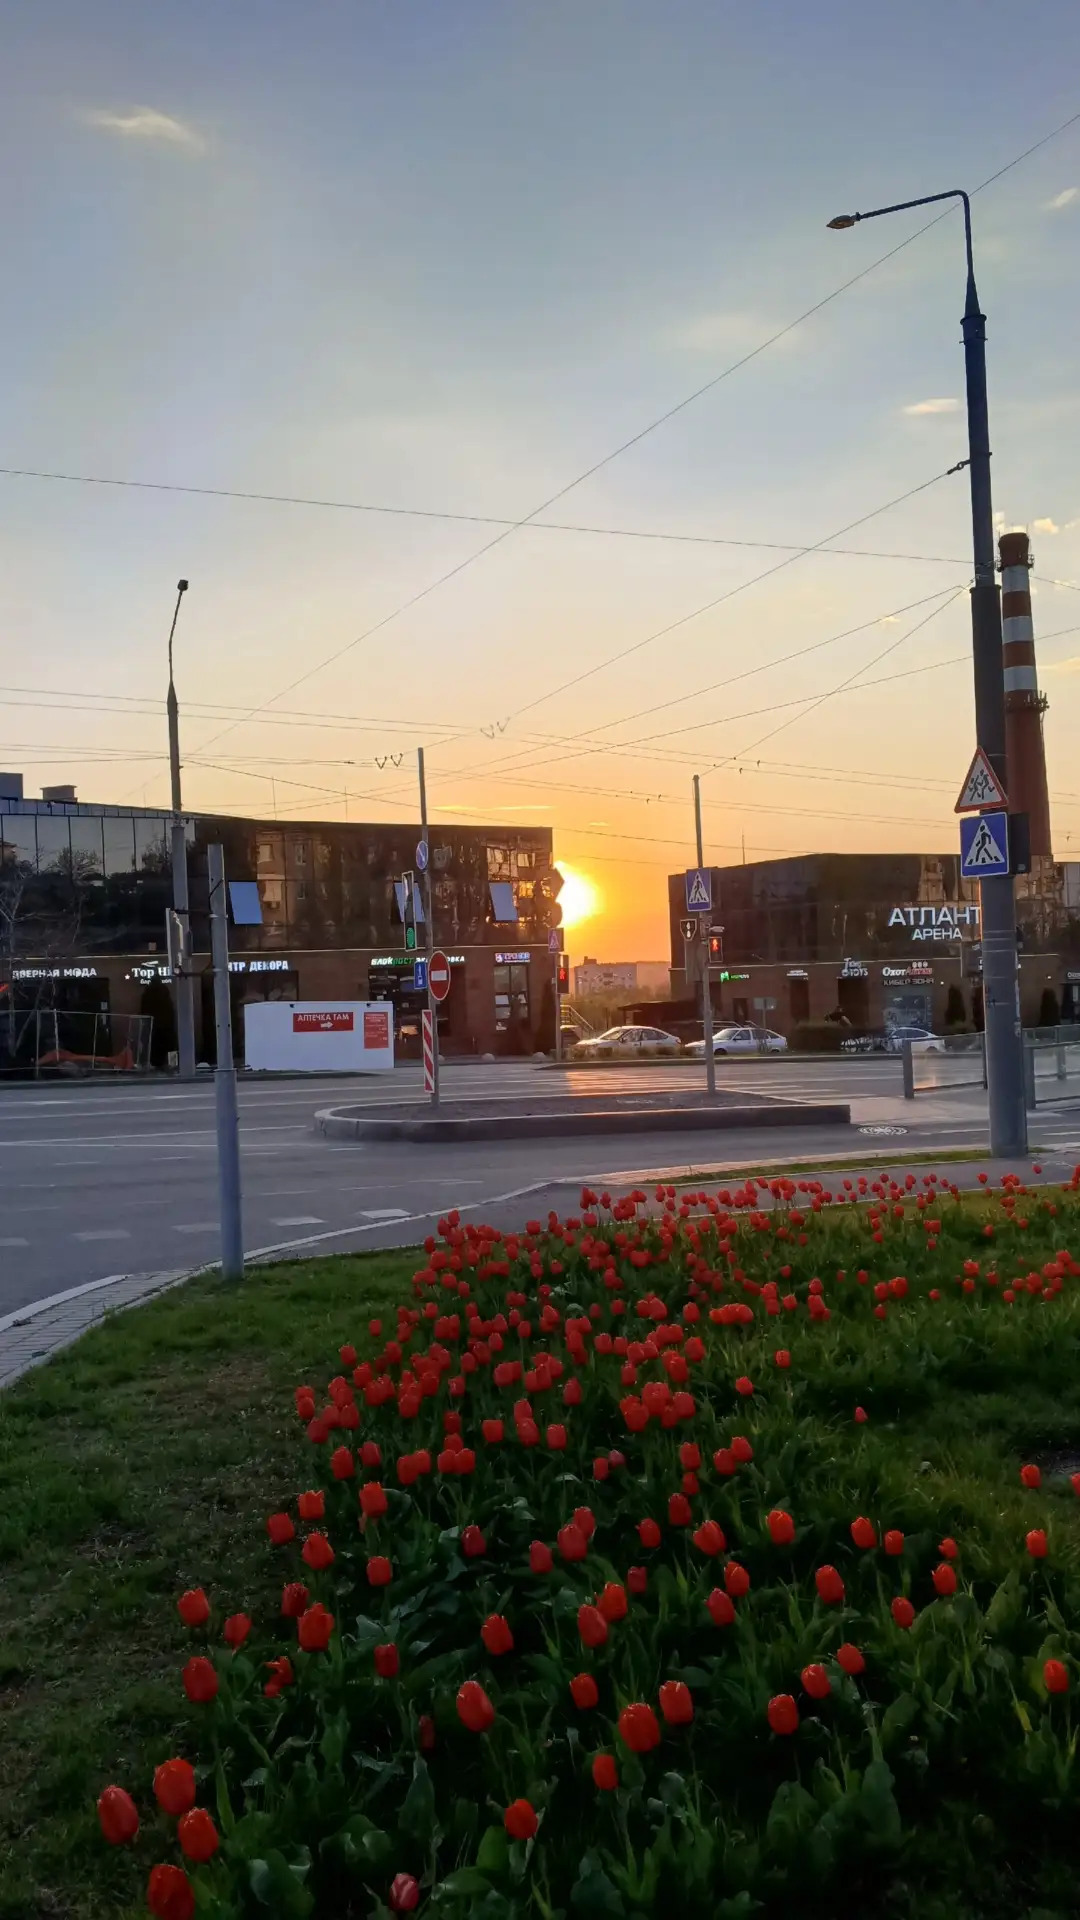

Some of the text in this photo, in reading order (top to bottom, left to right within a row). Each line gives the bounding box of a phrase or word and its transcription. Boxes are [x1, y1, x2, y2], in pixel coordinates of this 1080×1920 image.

[888, 907, 980, 926] АТЛАНТ
[912, 928, 963, 940] АРЕНА
[249, 960, 289, 972] ДЕКОРА
[12, 968, 97, 980] ДВЕРНАЯ МОДА
[132, 968, 155, 979] Top
[297, 1013, 331, 1022] АПТЕЧКА
